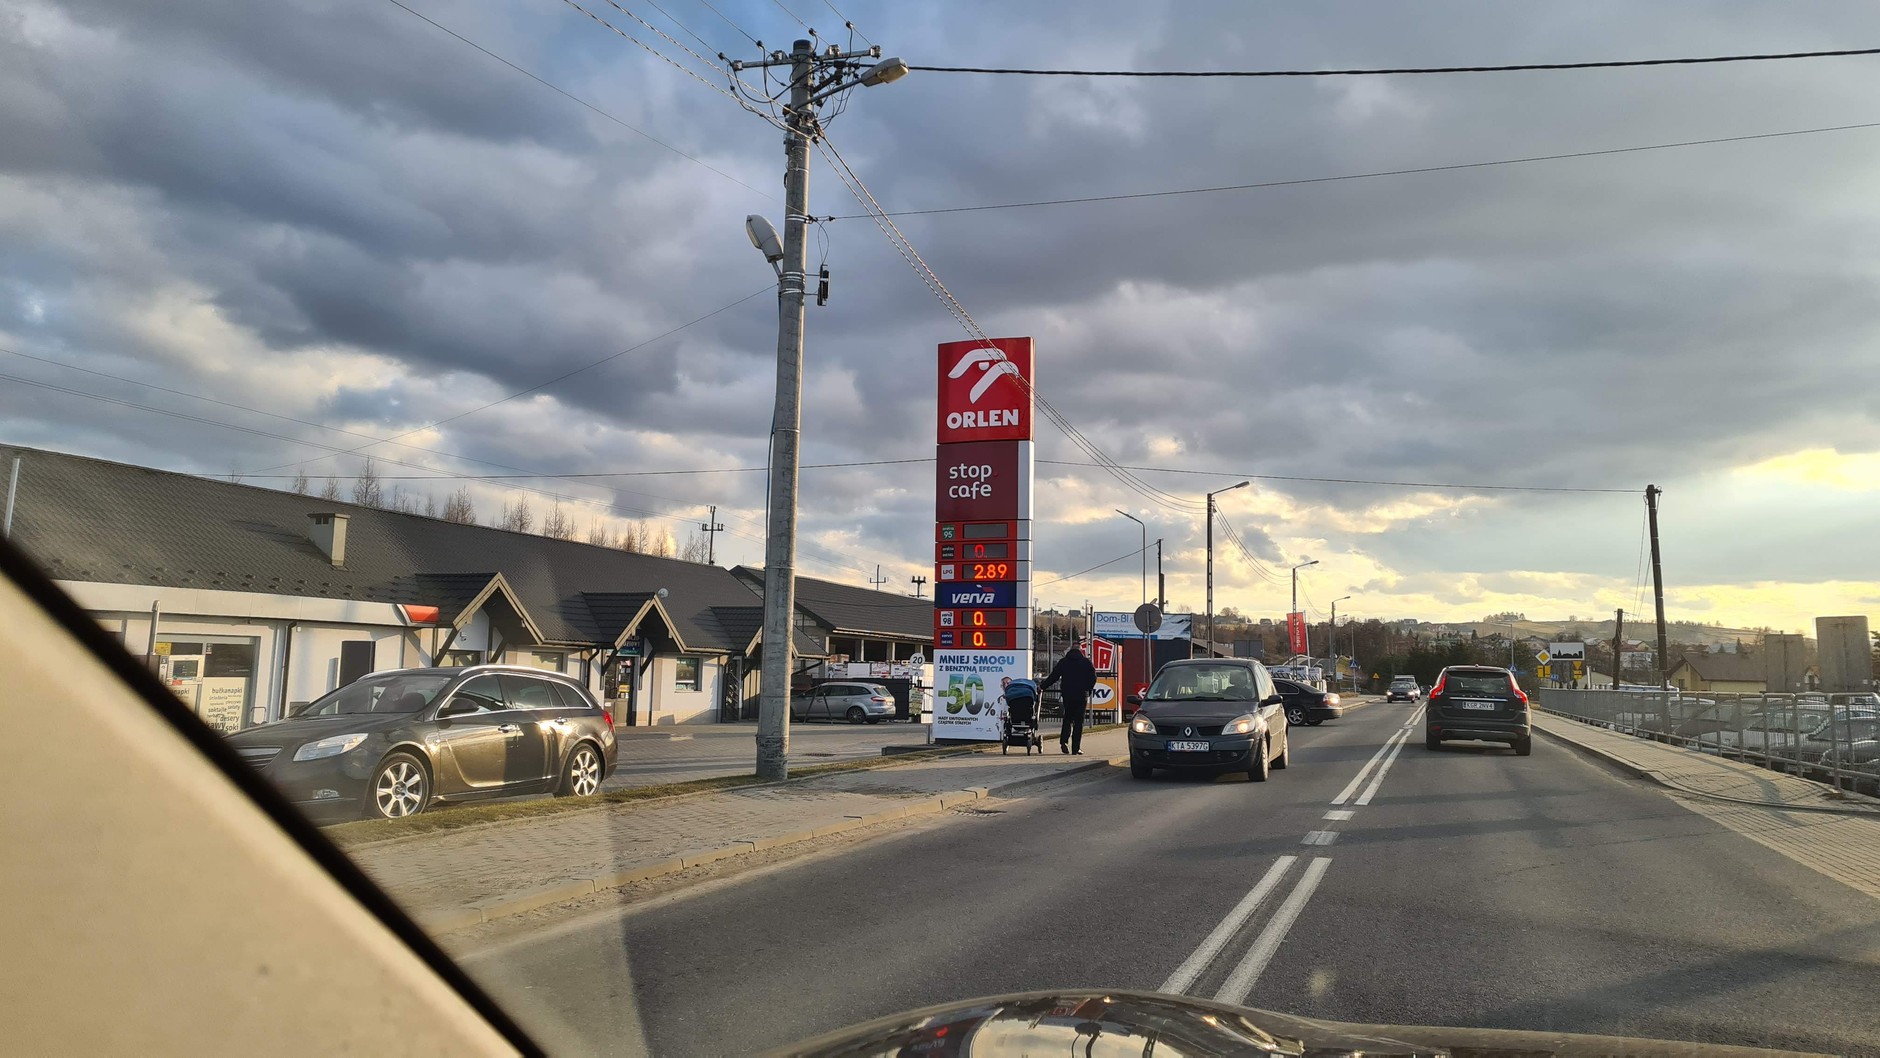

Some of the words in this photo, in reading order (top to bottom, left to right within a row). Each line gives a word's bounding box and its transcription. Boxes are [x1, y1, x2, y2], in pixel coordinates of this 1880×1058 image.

[946, 409, 1019, 429] ORLEN
[949, 463, 992, 482] stop
[949, 482, 992, 500] cafe
[943, 531, 953, 539] 95
[974, 564, 1008, 579] 2.89
[951, 592, 995, 604] verva
[912, 656, 923, 664] 20
[939, 655, 970, 665] MNIEJ
[973, 655, 1015, 665] SMOGU
[1092, 688, 1112, 699] KV
[225, 723, 239, 731] soki
[1171, 741, 1185, 750] KTA
